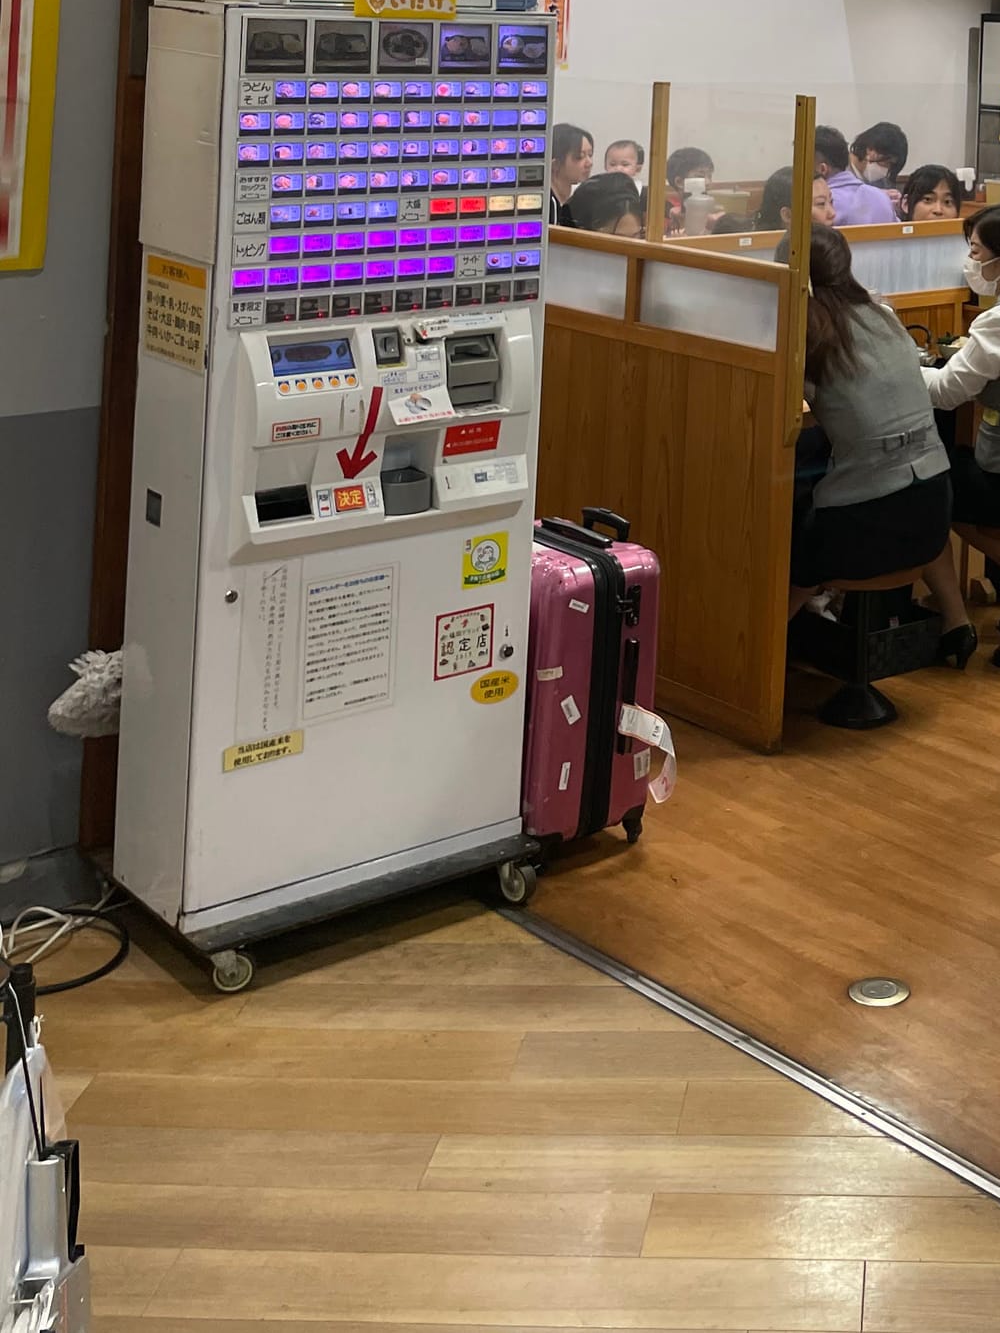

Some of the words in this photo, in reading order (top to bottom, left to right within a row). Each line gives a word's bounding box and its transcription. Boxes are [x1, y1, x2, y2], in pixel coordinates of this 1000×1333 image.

[242, 82, 271, 93] うどん
[236, 242, 266, 258] トッピング
[337, 489, 363, 508] 決定
[480, 677, 511, 690] 国産米
[484, 687, 505, 700] 使用
